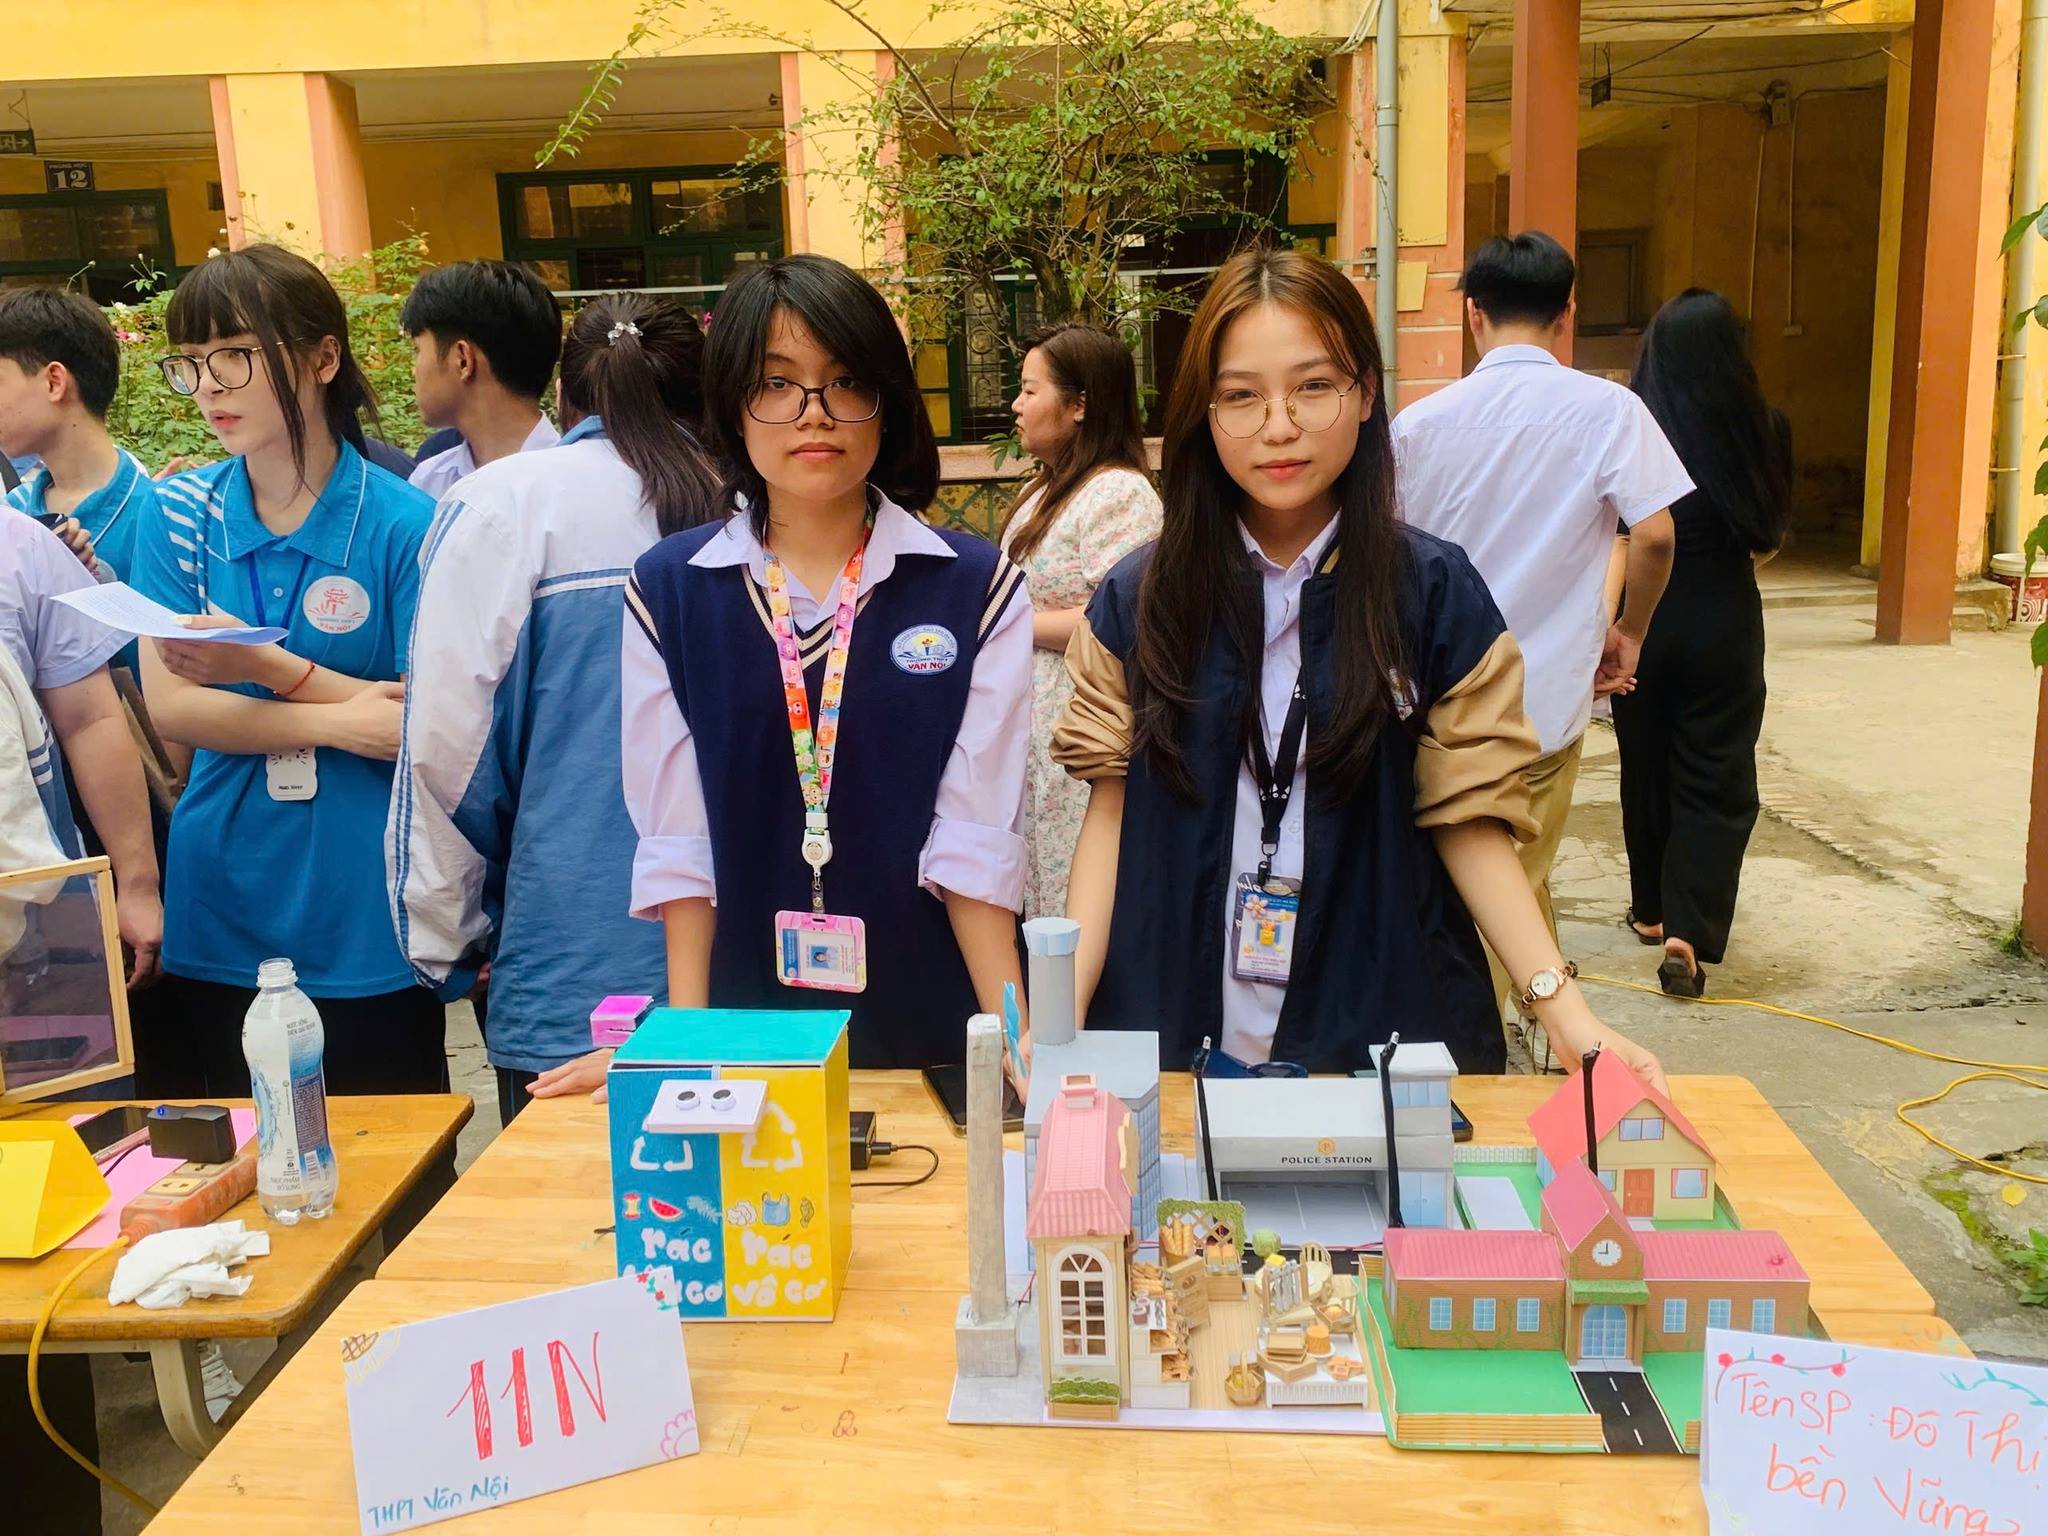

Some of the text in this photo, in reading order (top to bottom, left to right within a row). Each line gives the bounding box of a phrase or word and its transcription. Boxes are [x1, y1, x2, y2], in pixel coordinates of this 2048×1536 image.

[53, 169, 88, 189] 12
[1281, 1156, 1372, 1164] POLICE STATION
[447, 1331, 607, 1461] 11N
[367, 1498, 413, 1529] THPT
[471, 1475, 509, 1502] Nội
